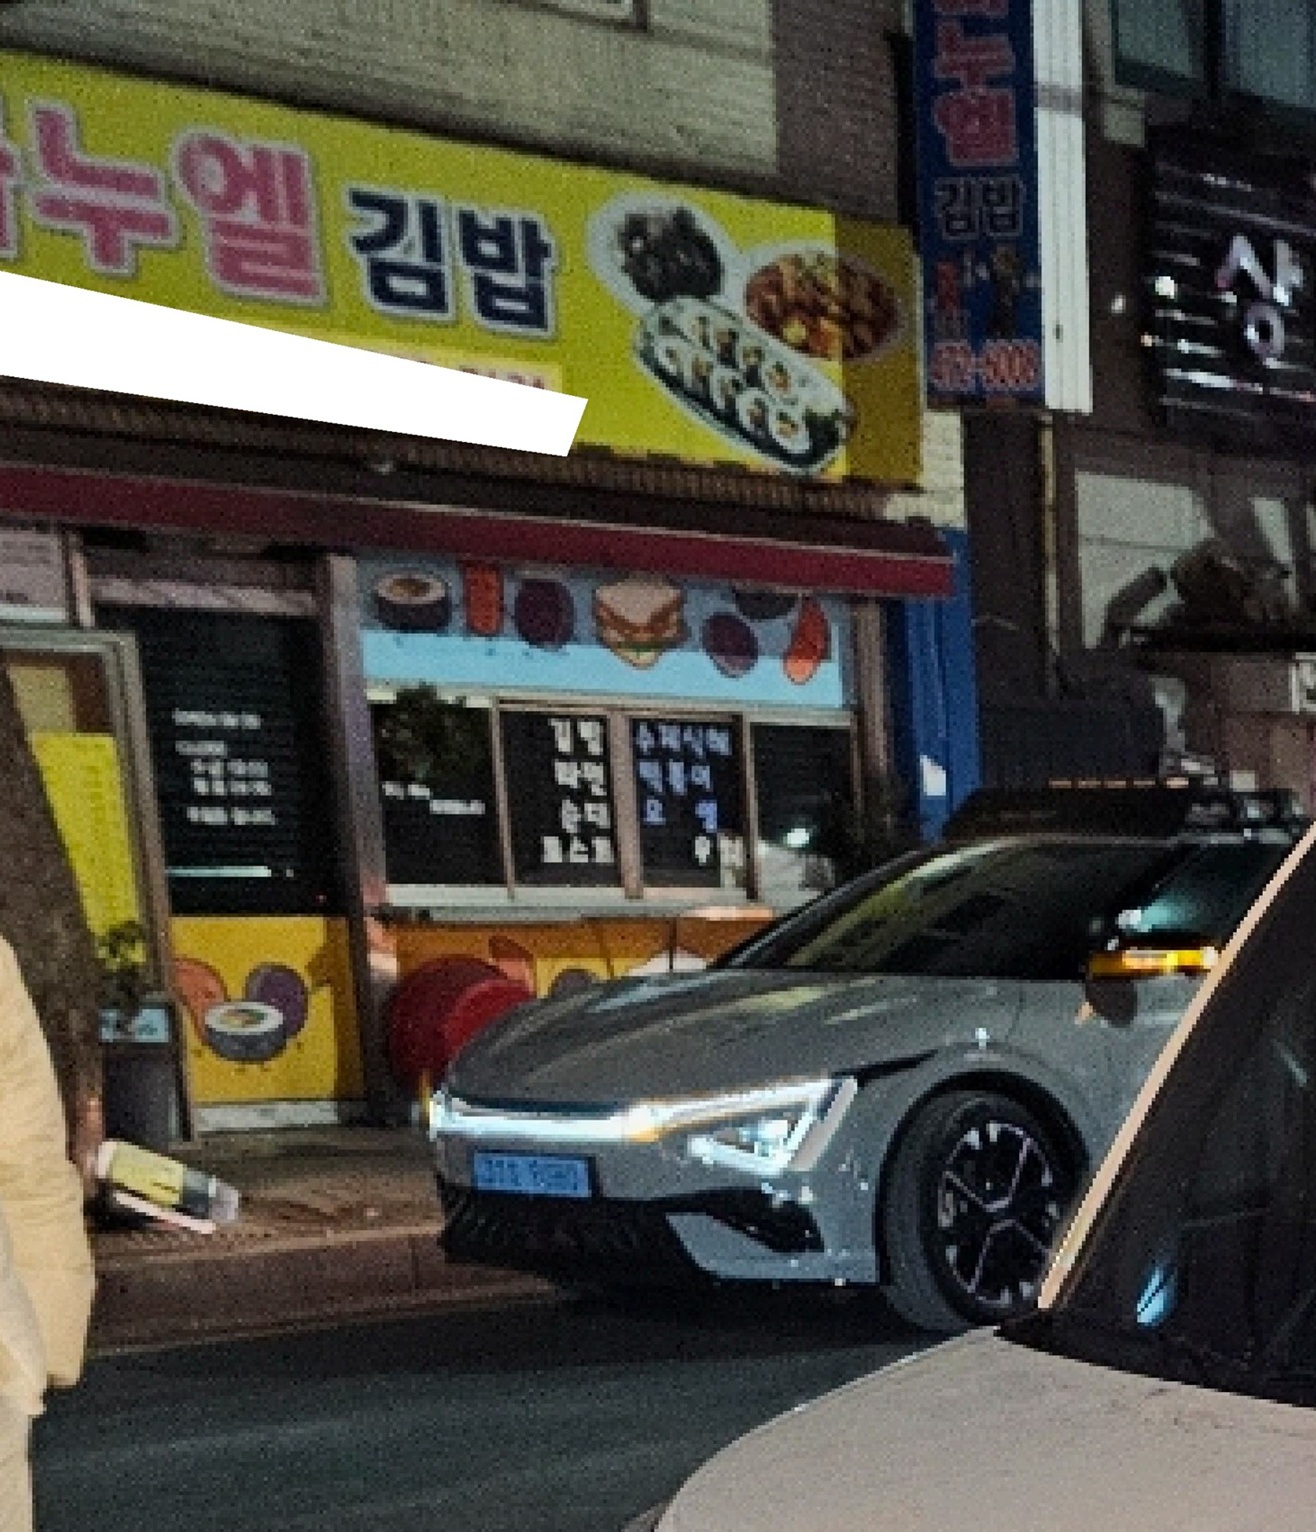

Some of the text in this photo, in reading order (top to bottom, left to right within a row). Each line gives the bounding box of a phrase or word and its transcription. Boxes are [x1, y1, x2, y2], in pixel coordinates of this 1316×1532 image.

[932, 0, 1020, 167] 누엘
[0, 96, 558, 339] 누엘 김밥
[934, 174, 1025, 240] 김밥
